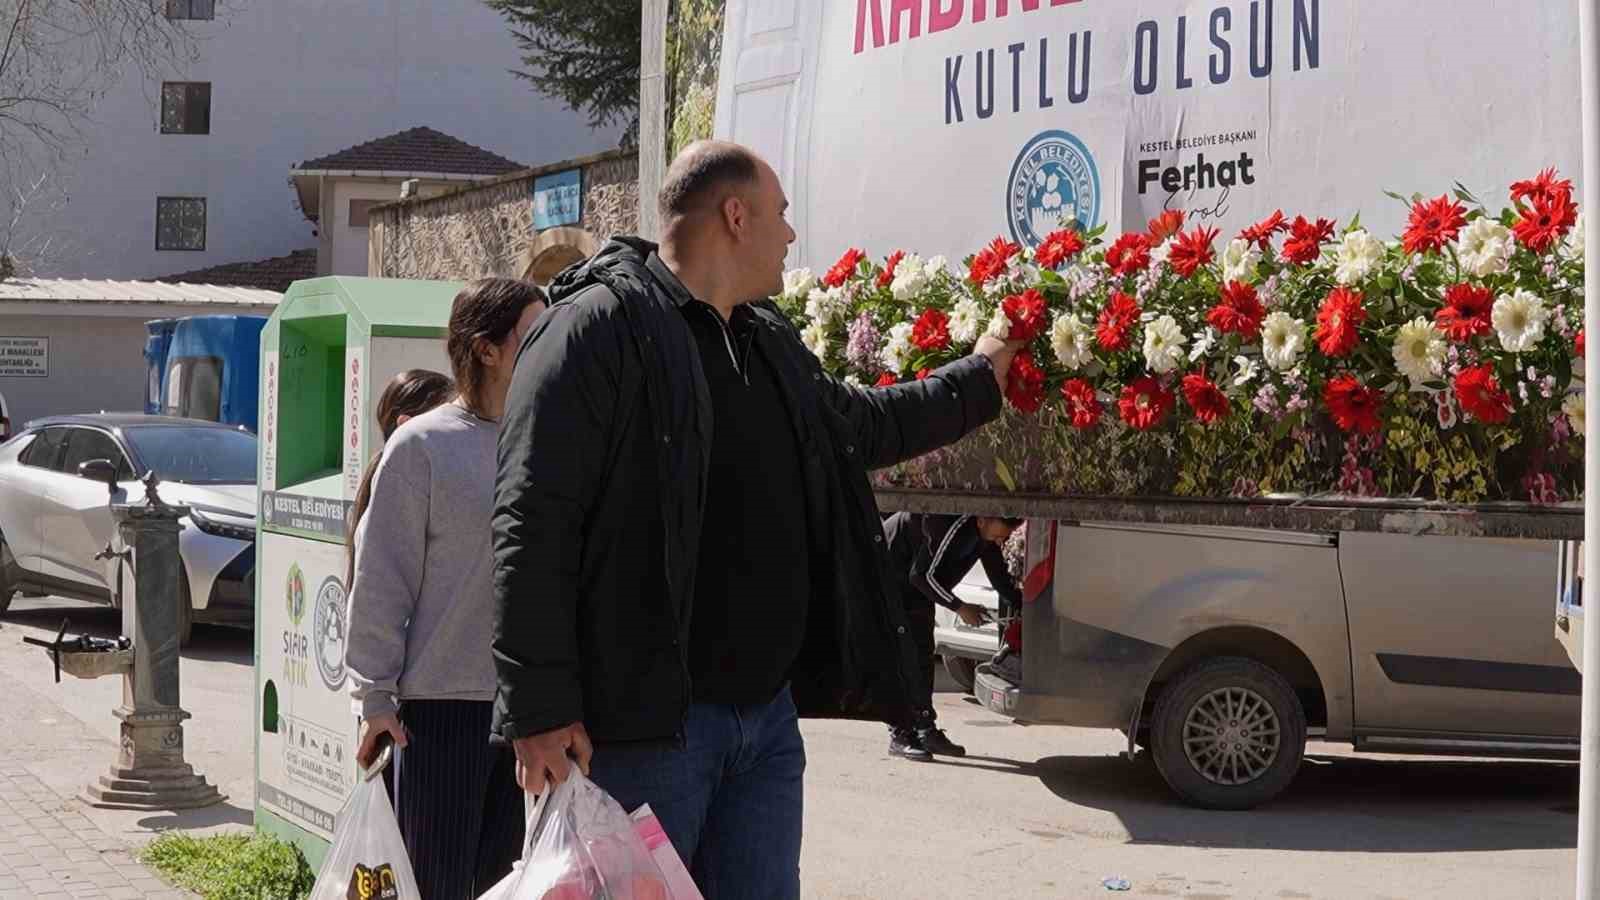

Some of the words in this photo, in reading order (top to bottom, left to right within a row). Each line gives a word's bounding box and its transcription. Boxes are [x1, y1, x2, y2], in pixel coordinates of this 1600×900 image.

[944, 30, 1092, 125] KUTLU
[1133, 0, 1320, 96] OLSUN
[1139, 141, 1174, 153] KESTEL
[1175, 134, 1218, 151] BELEDİYE
[1219, 129, 1257, 145] BAŞKANI
[1016, 158, 1039, 220] KESTEL
[1138, 151, 1256, 195] Ferhat
[274, 497, 301, 514] KESTEL
[301, 499, 345, 521] BELEDİYESİ
[282, 656, 309, 689] ATIK
